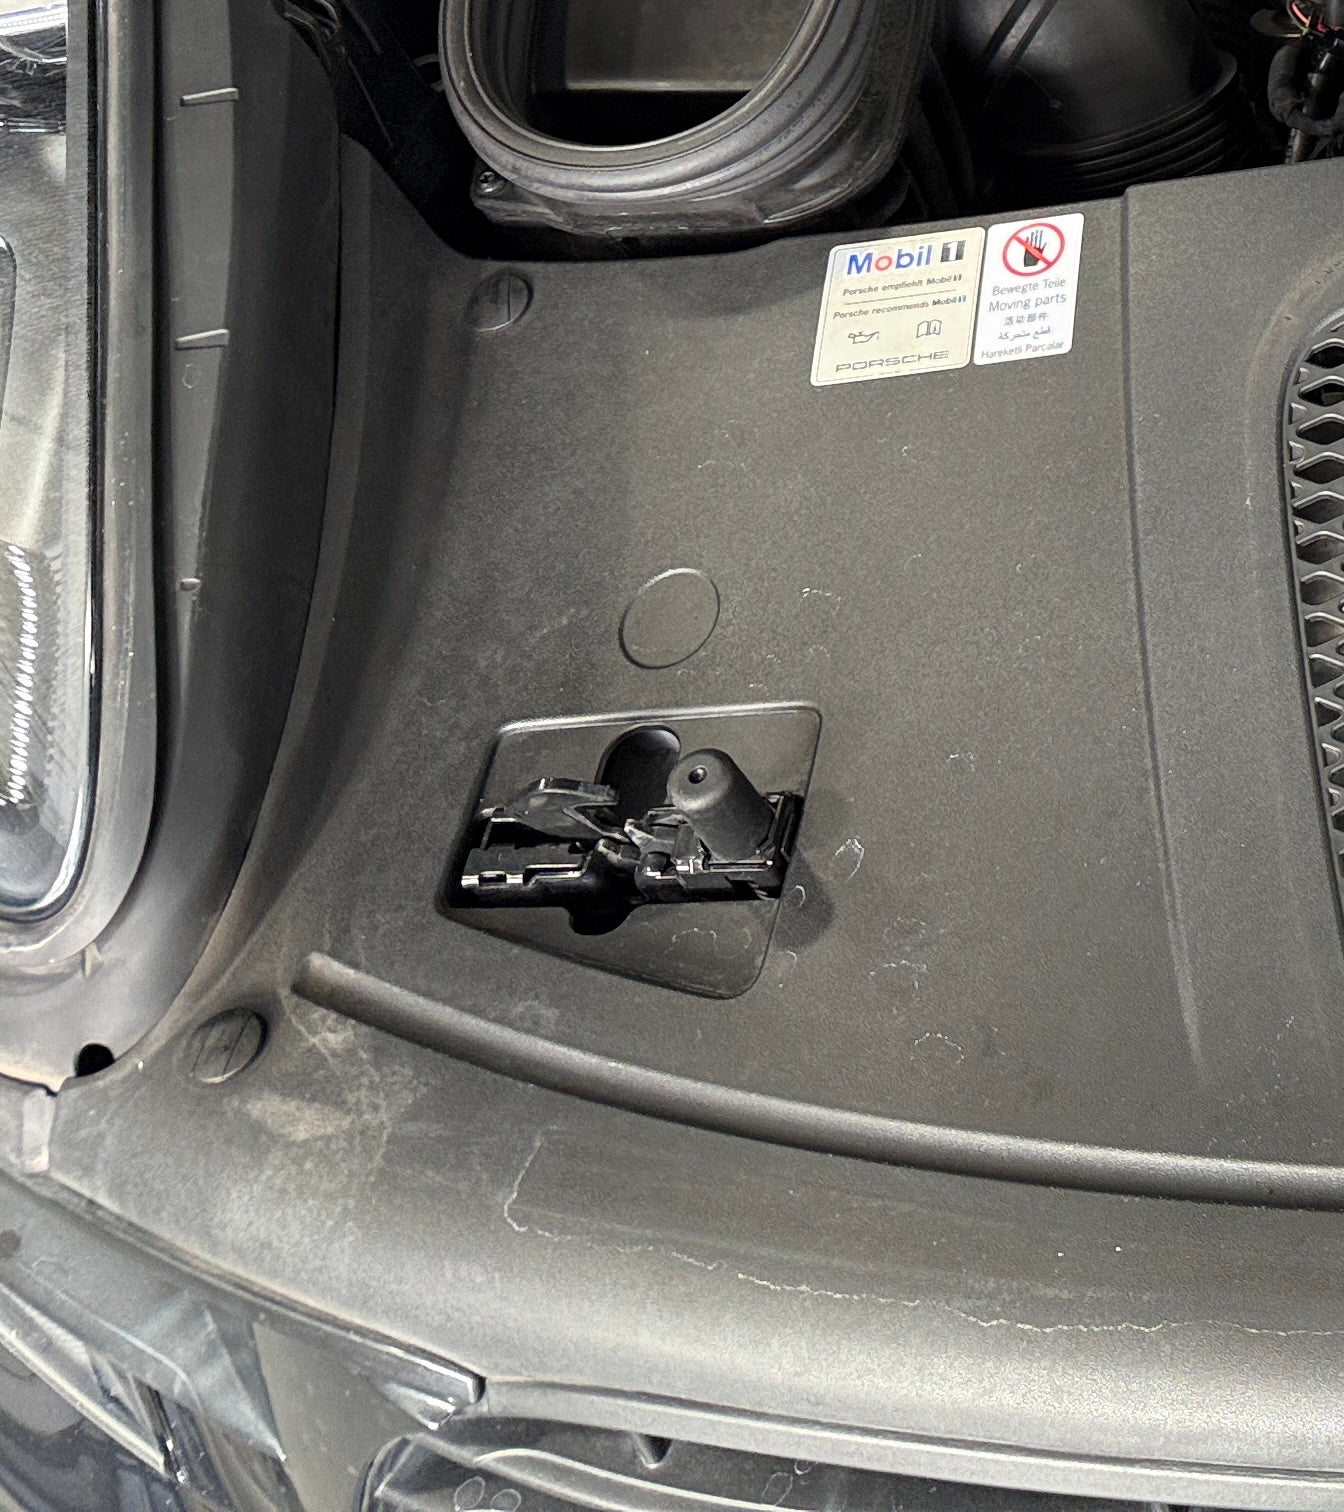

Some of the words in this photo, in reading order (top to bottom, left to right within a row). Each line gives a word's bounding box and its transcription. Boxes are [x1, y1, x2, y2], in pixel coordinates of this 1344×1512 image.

[847, 245, 933, 275] Mobil
[843, 285, 878, 296] Porsche
[926, 275, 952, 286] Mobil
[992, 283, 1039, 296] Bewegte
[833, 309, 869, 320] Porsche
[872, 301, 929, 314] recommends
[932, 296, 956, 307] Mobil
[988, 298, 1031, 312] Moving
[1035, 293, 1067, 308] parts
[836, 350, 950, 372] PORSCHE
